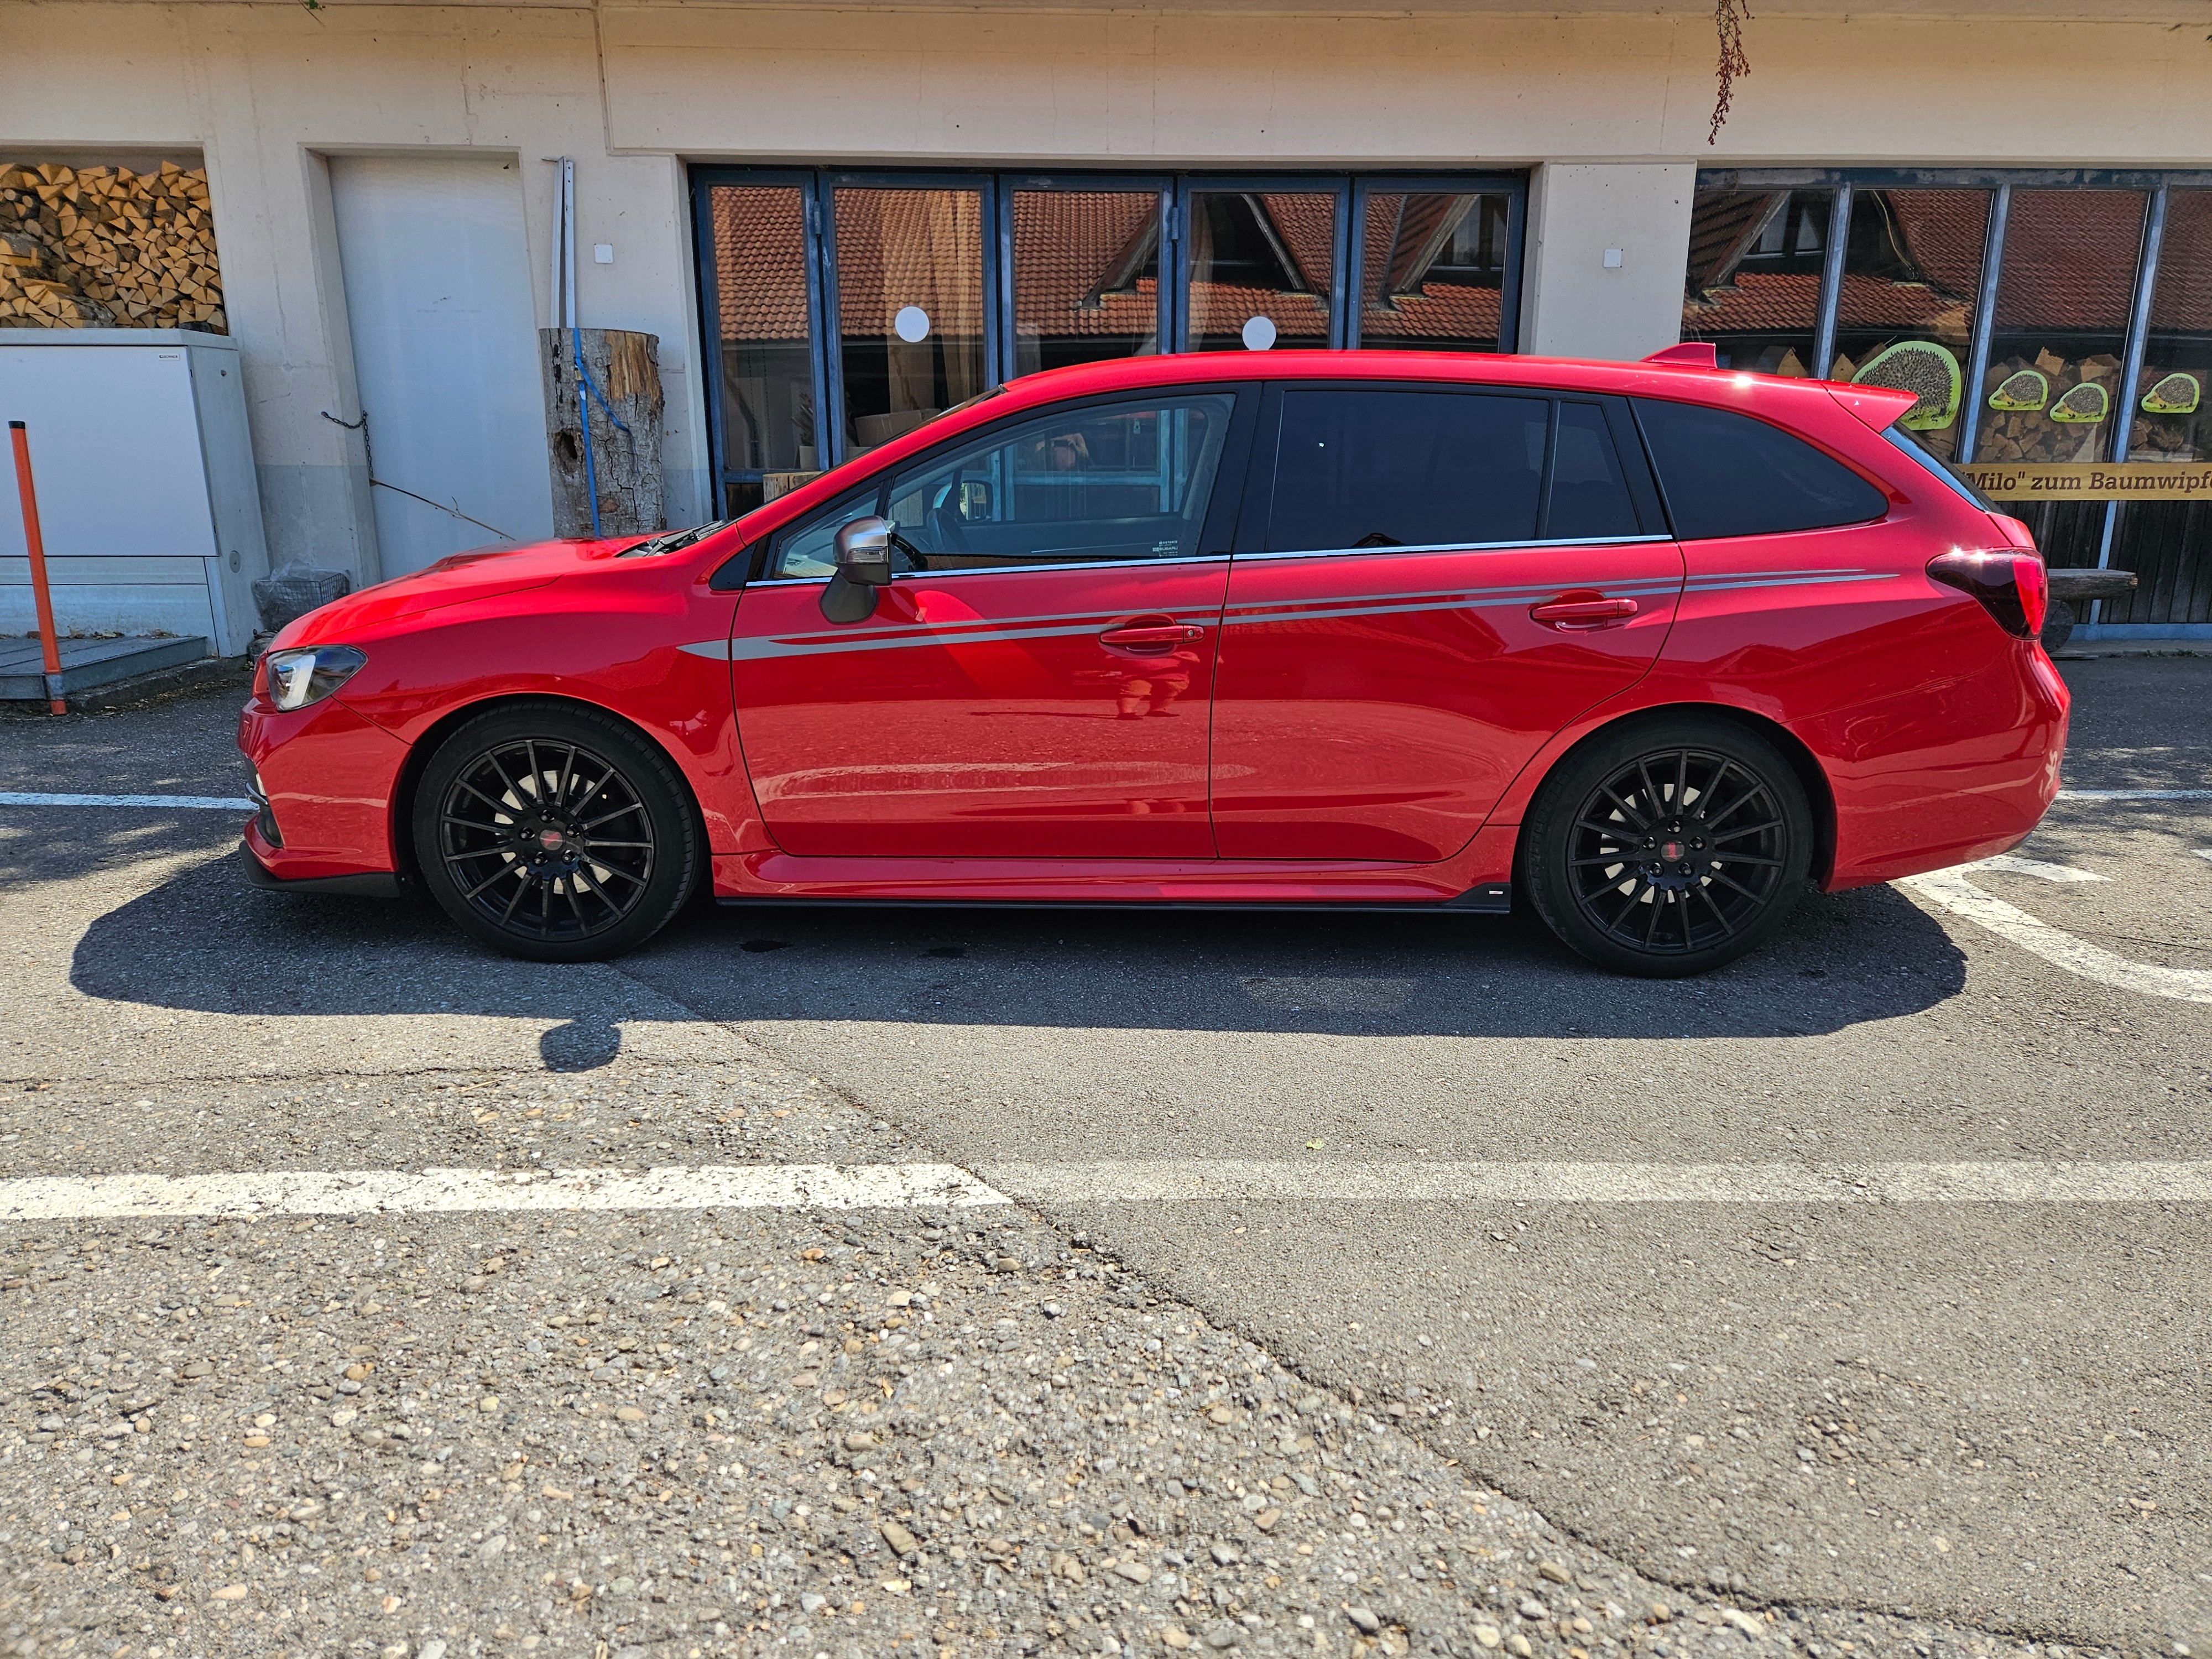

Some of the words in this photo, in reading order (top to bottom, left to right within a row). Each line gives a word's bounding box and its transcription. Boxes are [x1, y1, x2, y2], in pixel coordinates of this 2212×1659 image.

[1963, 471, 2026, 491] Milo"
[2031, 476, 2081, 490] zum
[2089, 471, 2212, 493] Baumwipf
